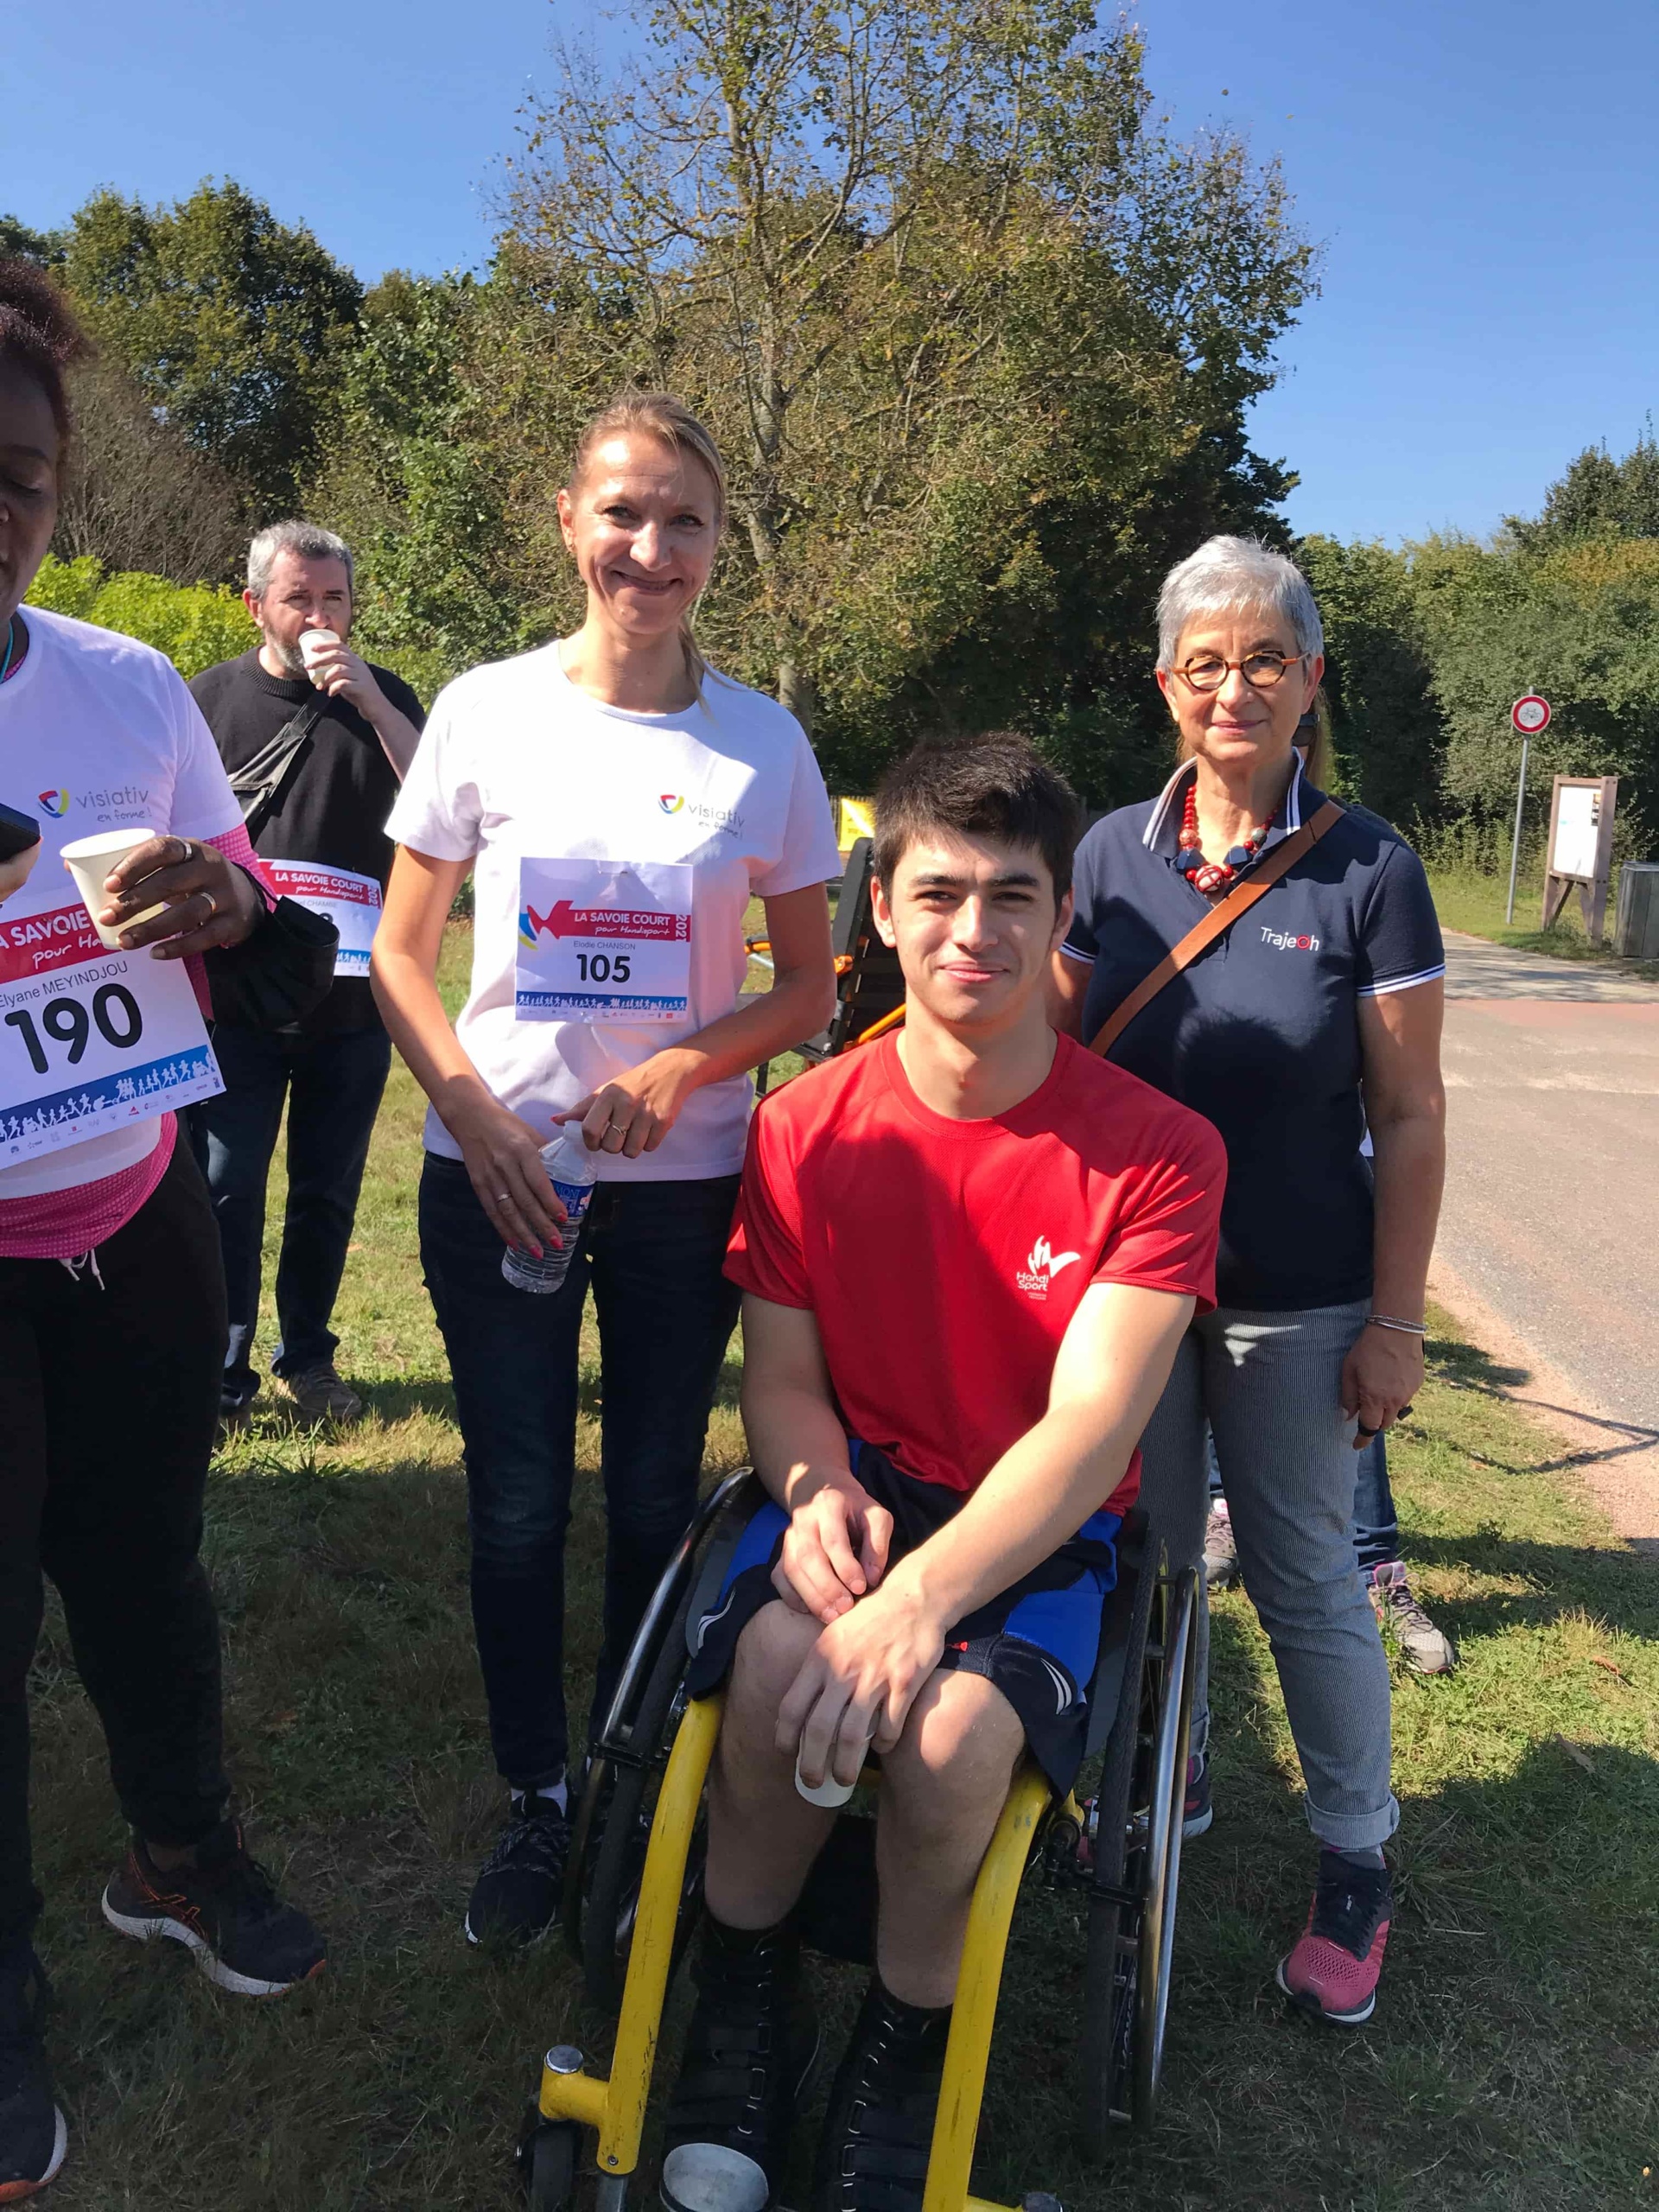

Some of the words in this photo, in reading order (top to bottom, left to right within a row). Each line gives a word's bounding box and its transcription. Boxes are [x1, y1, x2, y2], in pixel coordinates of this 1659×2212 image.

[75, 786, 149, 809] visiativ
[98, 813, 111, 823] en
[688, 804, 745, 828] visiativ
[275, 872, 289, 882] LA
[290, 873, 329, 886] SAVOIE
[330, 876, 364, 893] COURT
[10, 909, 91, 946] SAVOIE
[574, 912, 588, 923] LA
[590, 912, 630, 924] SAVOIE
[632, 913, 671, 926] COURT
[594, 926, 617, 935] pour
[620, 925, 670, 938] Handisport
[32, 944, 72, 969] pour
[597, 941, 636, 950] CHANSON
[41, 960, 128, 995] MEYINDJOU
[576, 954, 631, 983] 105
[4, 982, 143, 1074] 190
